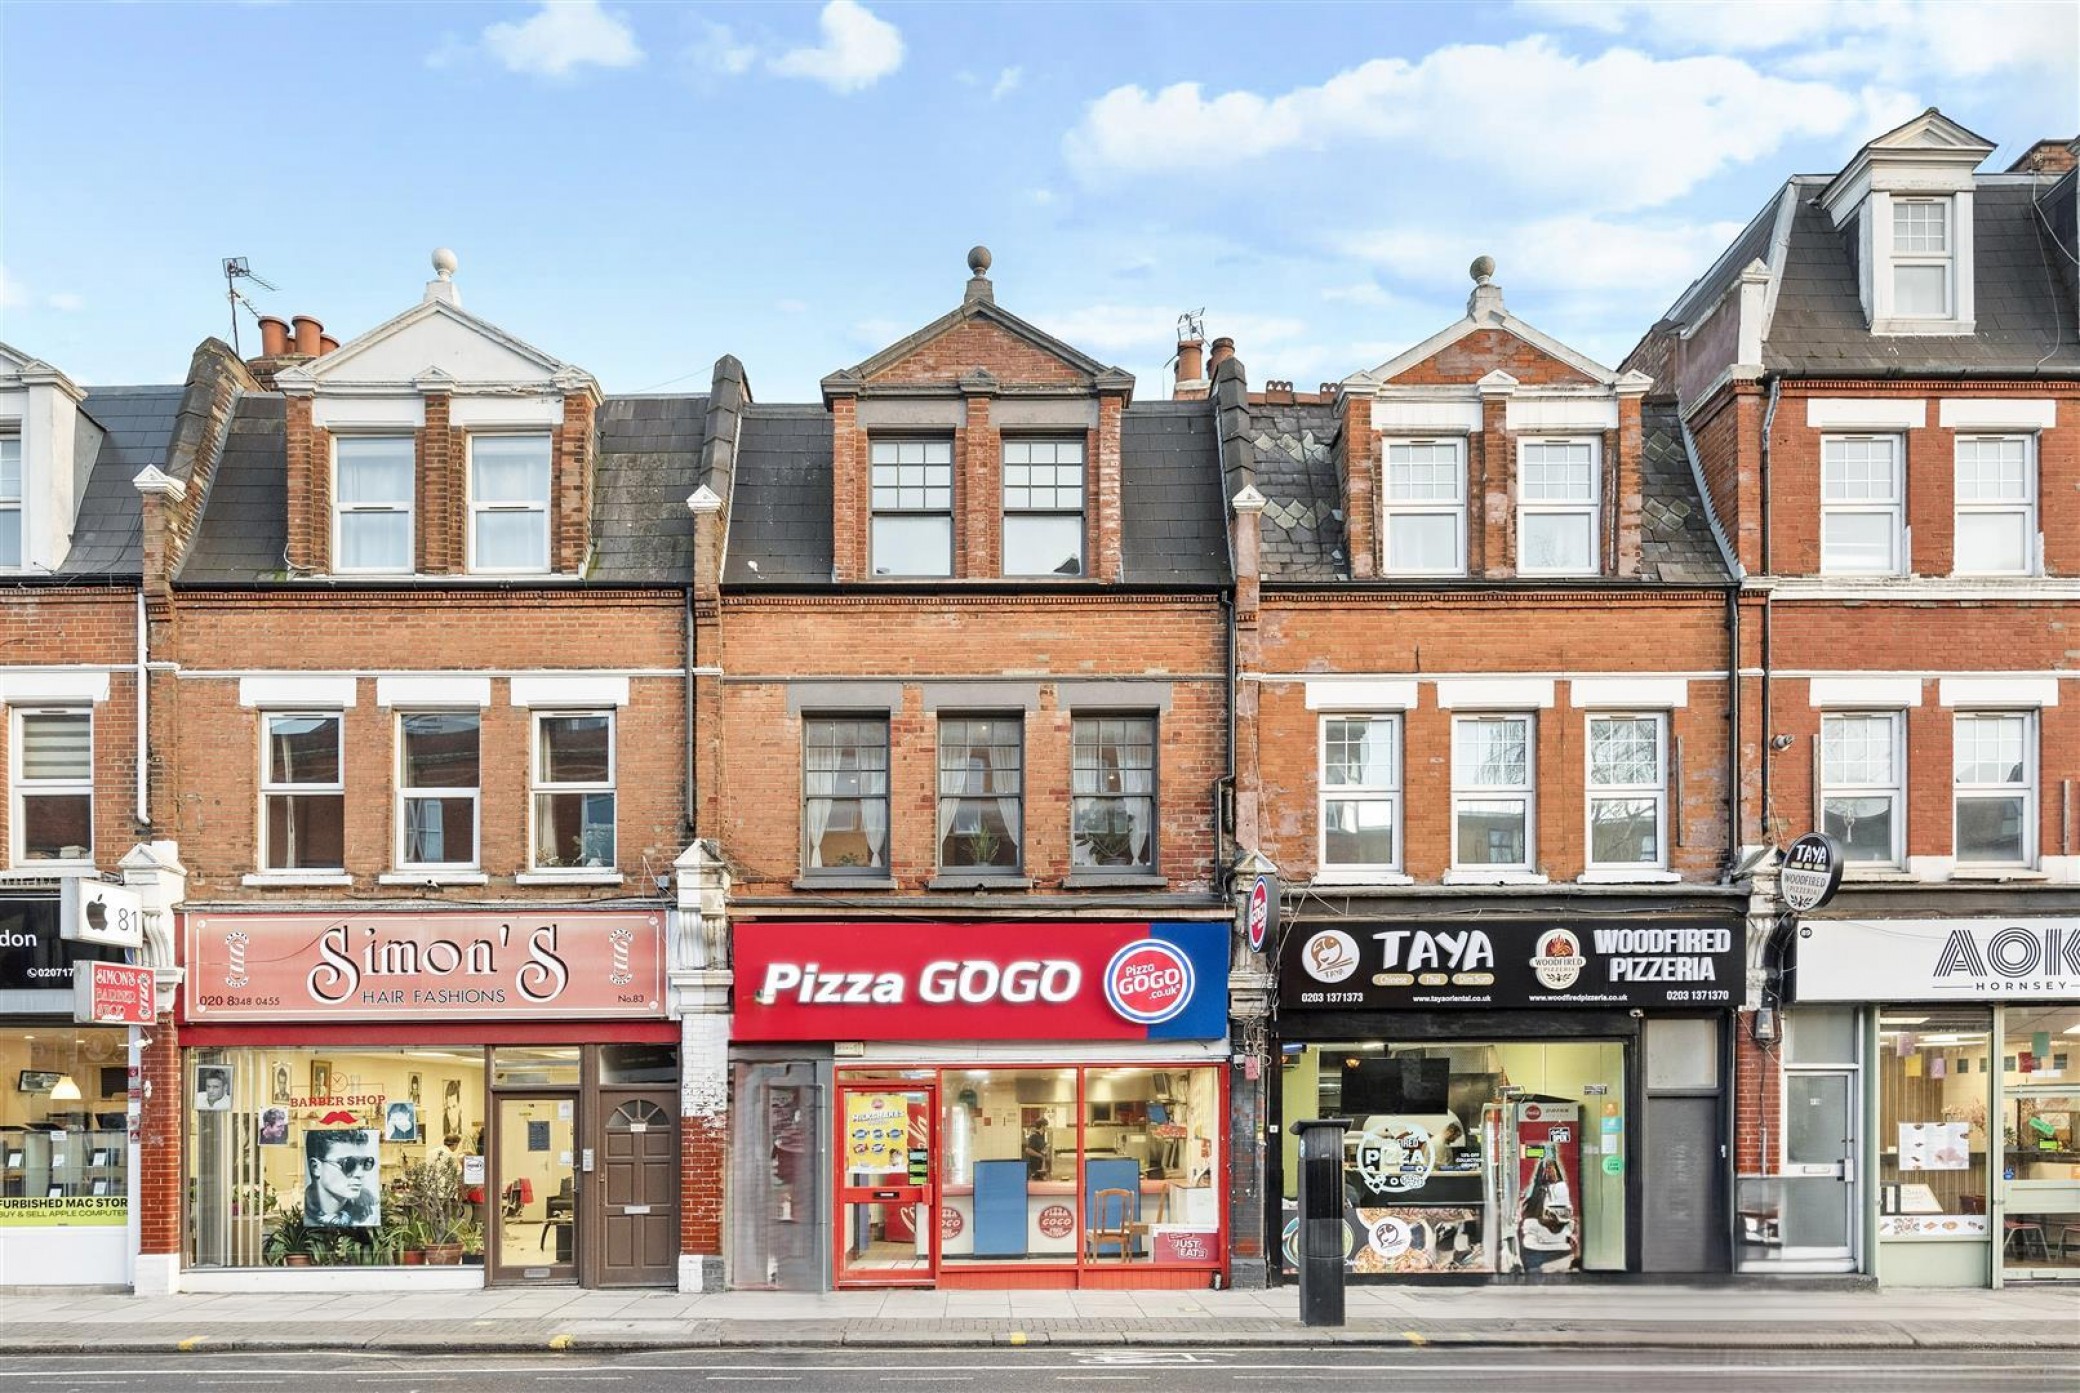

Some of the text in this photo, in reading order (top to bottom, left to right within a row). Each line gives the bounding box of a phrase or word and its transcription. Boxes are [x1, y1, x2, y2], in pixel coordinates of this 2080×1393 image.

[1796, 845, 1827, 863] TAYA
[118, 908, 138, 932] 81
[0, 929, 37, 947] don
[1593, 929, 1730, 954] WOODFIRED
[1372, 930, 1494, 972] TAYA
[1933, 927, 2080, 978] AOK
[96, 968, 137, 986] SIMON'S
[1125, 963, 1155, 977] Pizza
[1609, 957, 1716, 982] PIZZERIA
[759, 959, 1082, 1005] Pizza GOGO
[1118, 968, 1180, 995] GOGO
[1975, 981, 2067, 991] HORNSEY
[200, 995, 280, 1006] 020 8348 0455
[363, 989, 506, 1003] HAIR FASHIONS
[1301, 992, 1364, 1003] 0203 1371373
[1666, 990, 1729, 1001] 0203 1371370
[290, 1094, 386, 1108] BARBER SHOP
[66, 1199, 94, 1208] MAC
[25, 1210, 49, 1218] SELL
[1175, 1240, 1200, 1249] JUST
